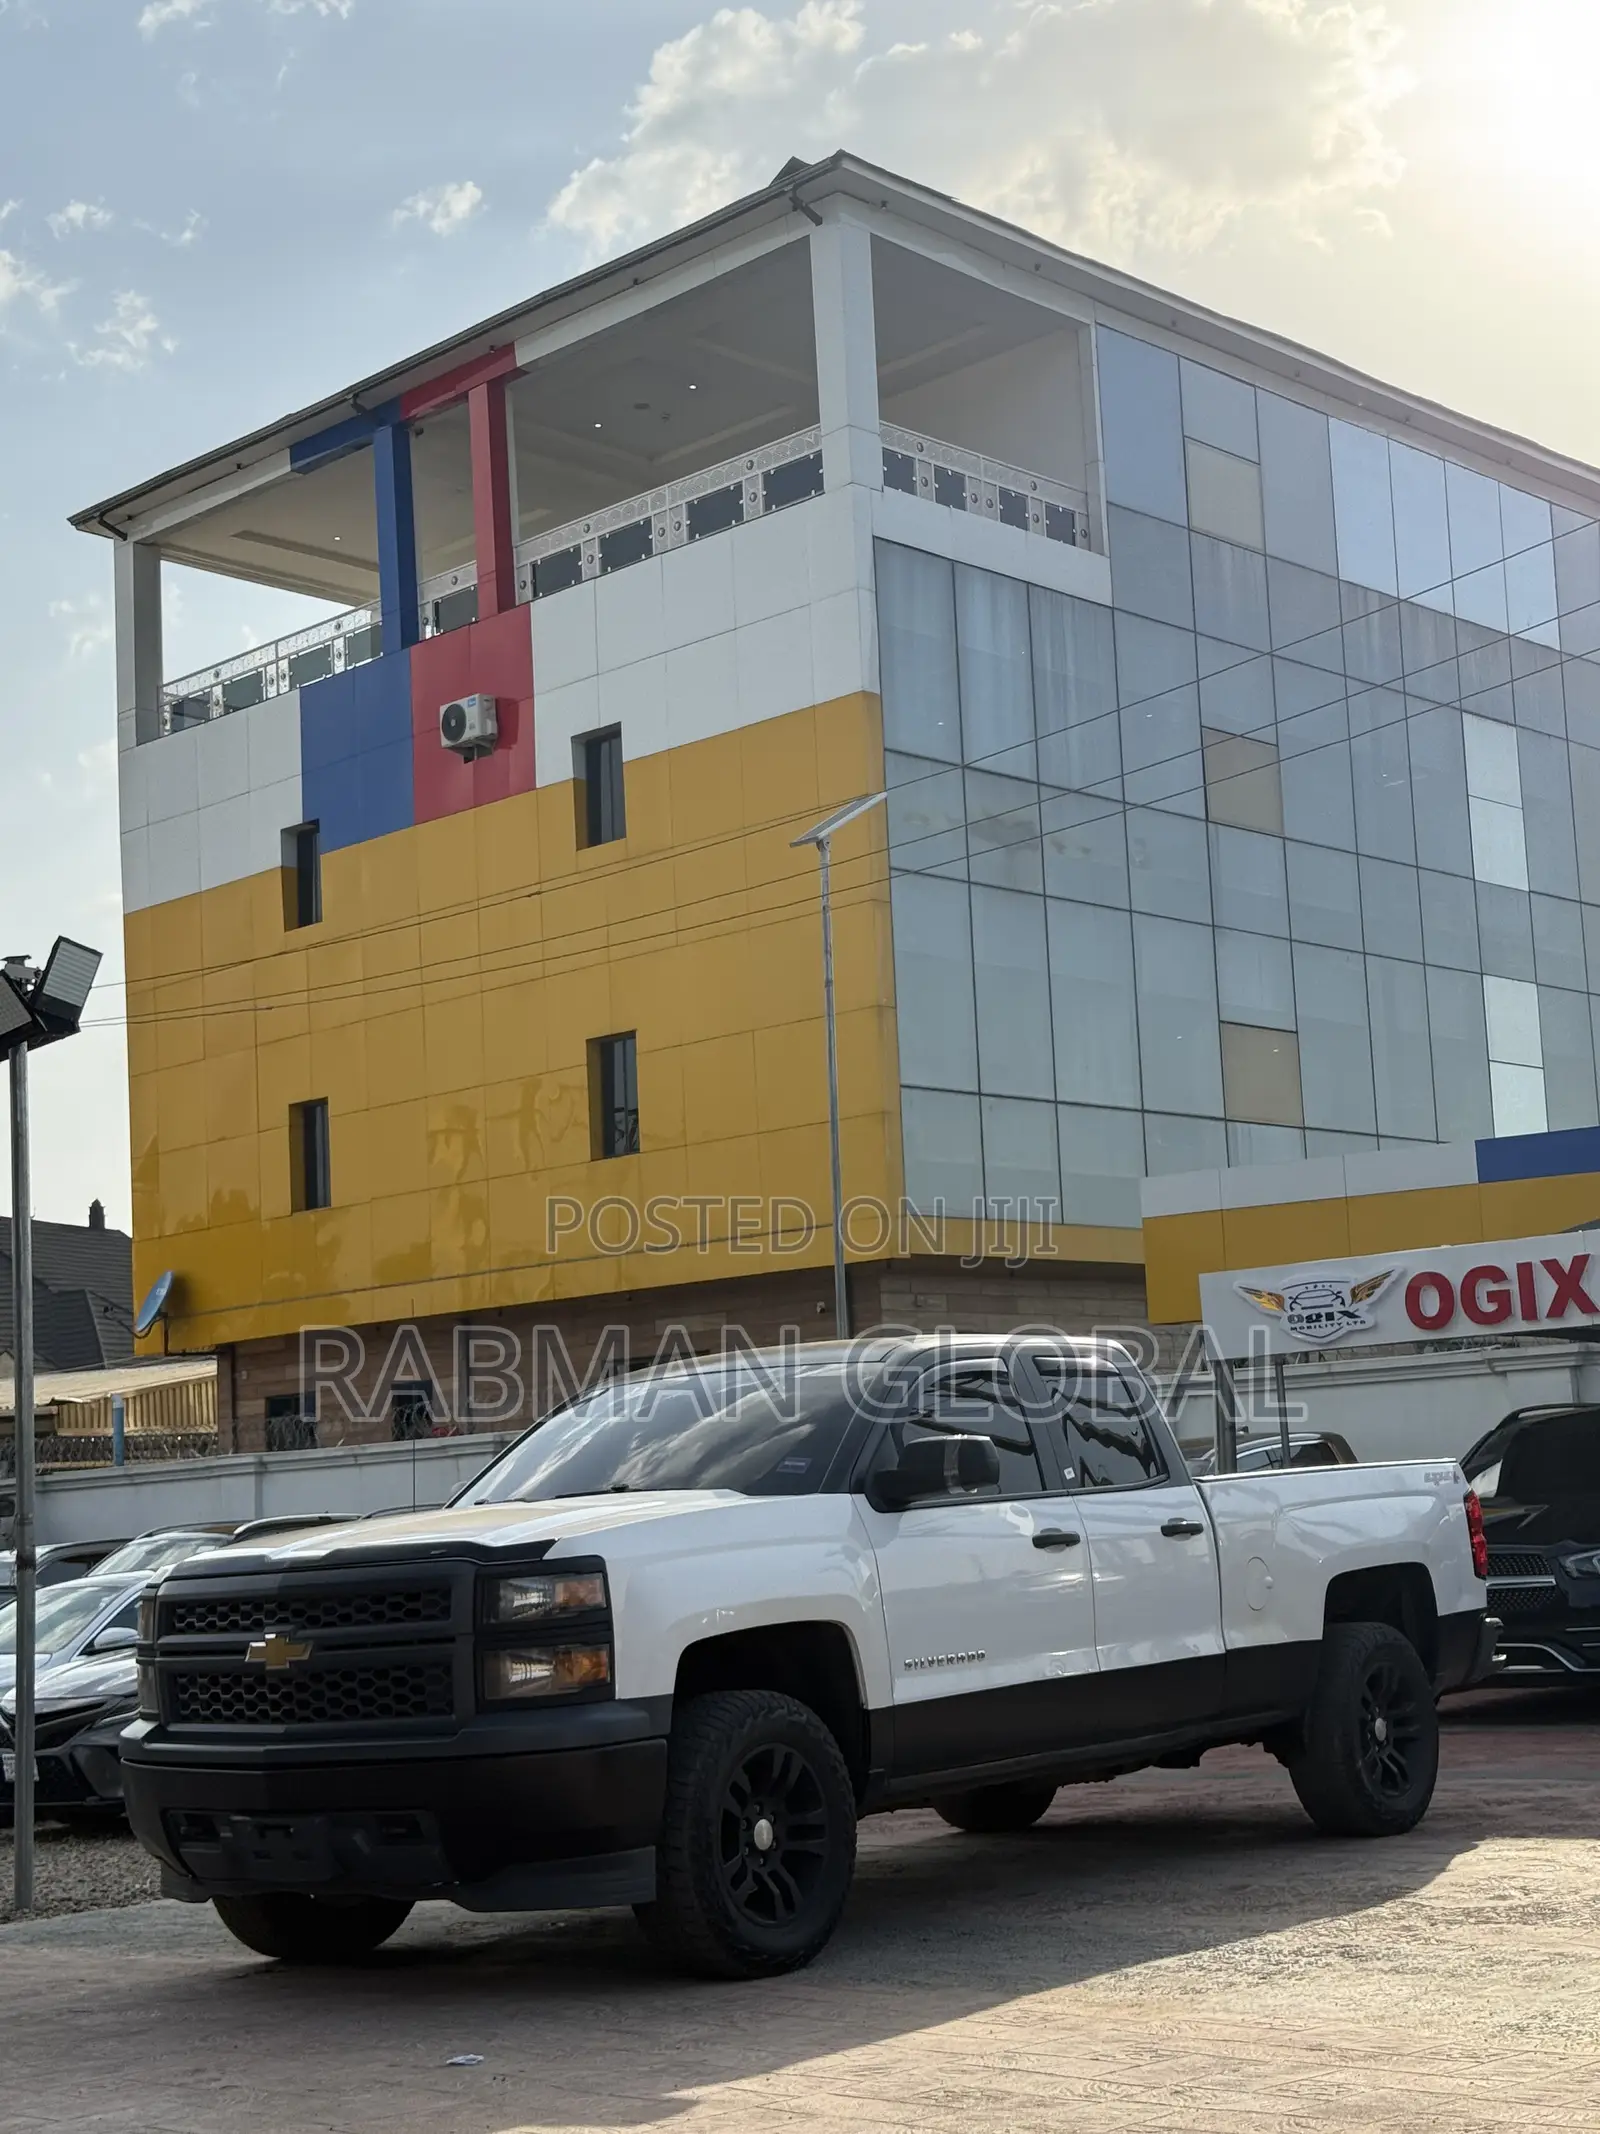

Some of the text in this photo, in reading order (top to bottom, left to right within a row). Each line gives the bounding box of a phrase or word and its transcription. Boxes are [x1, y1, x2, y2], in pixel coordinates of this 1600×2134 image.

[1404, 1253, 1600, 1331] OGIX
[1290, 1321, 1343, 1332] MOBILITY
[903, 1649, 987, 1671] SILVERADO
